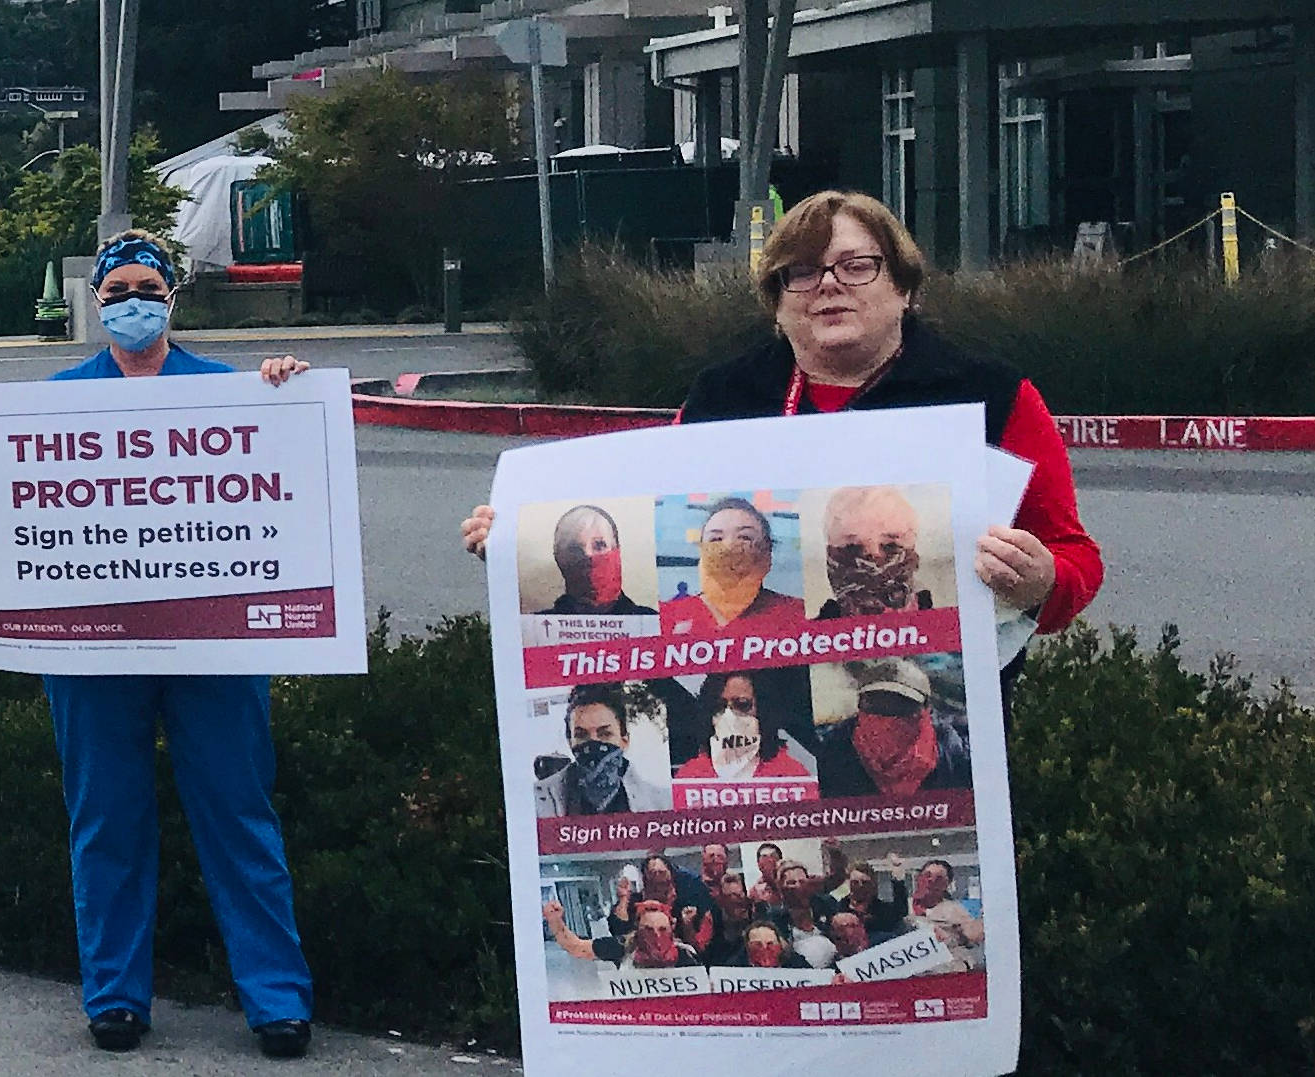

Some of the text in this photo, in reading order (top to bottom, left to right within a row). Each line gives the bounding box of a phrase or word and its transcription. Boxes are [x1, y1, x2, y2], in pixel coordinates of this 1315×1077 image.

[7, 425, 260, 463] THIS IS NOT
[1160, 418, 1247, 448] LANE
[11, 472, 294, 509] PROTECTION.
[14, 525, 74, 550] Sign
[82, 523, 129, 545] the
[138, 521, 251, 548] petition
[16, 558, 281, 581] ProtectNurses.org
[2, 622, 22, 632] OUR
[71, 624, 92, 633] OUR
[557, 622, 929, 678] This Is NOT Protection.
[685, 786, 807, 808] PROTECT
[558, 825, 603, 846] Sign
[607, 822, 641, 841] the
[646, 816, 728, 839] Petition
[752, 800, 950, 831] ProtectNurses.org
[609, 975, 699, 997] NURSES
[854, 936, 940, 982] MASKS!
